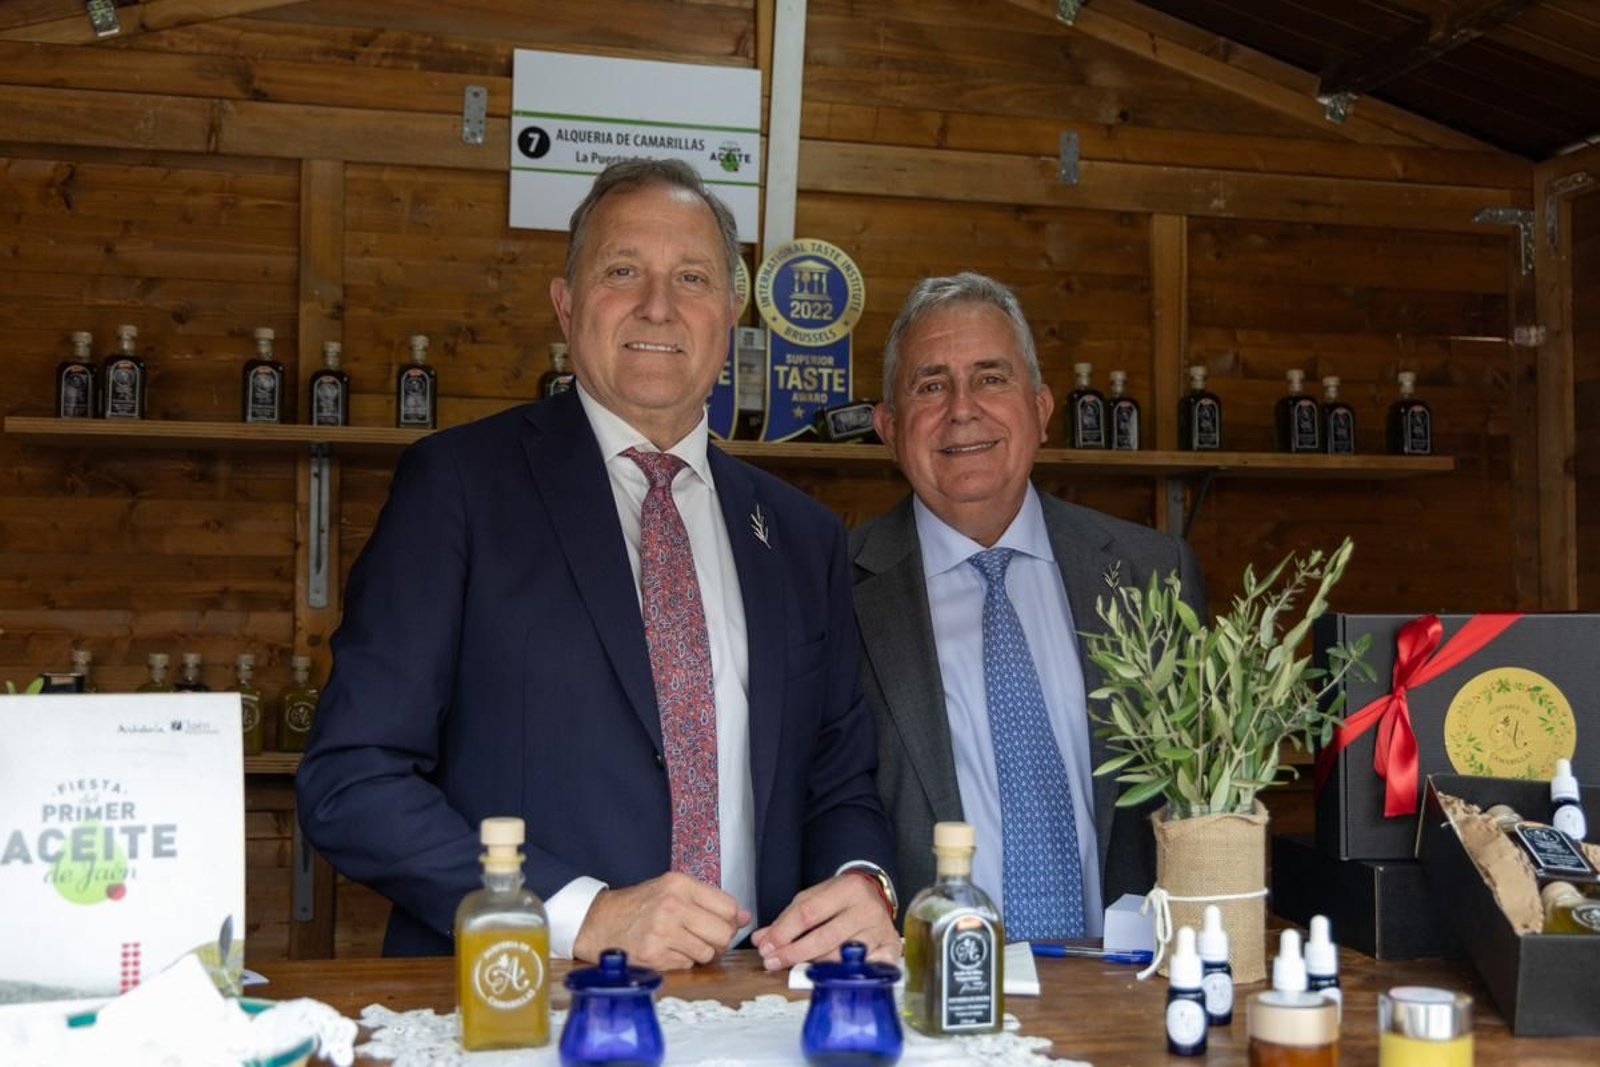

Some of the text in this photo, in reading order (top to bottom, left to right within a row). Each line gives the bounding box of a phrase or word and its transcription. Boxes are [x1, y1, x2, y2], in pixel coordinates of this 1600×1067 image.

[528, 132, 540, 152] 7
[556, 128, 613, 146] ALQUERIA
[616, 132, 631, 146] DE
[633, 133, 706, 152] CAMARILLAS
[575, 151, 588, 163] La
[758, 244, 807, 308] INTERNATIONAL
[810, 243, 842, 261] TASTE
[841, 260, 863, 312] INSTITUTE
[789, 301, 834, 321] 2022
[785, 325, 837, 342] BRUSSELS
[785, 354, 835, 366] SUPERIOR
[773, 365, 847, 392] TASTE
[791, 392, 829, 404] AWARD
[42, 802, 136, 823] PRIMER
[0, 824, 178, 866] ACEITE
[43, 857, 73, 884] de
